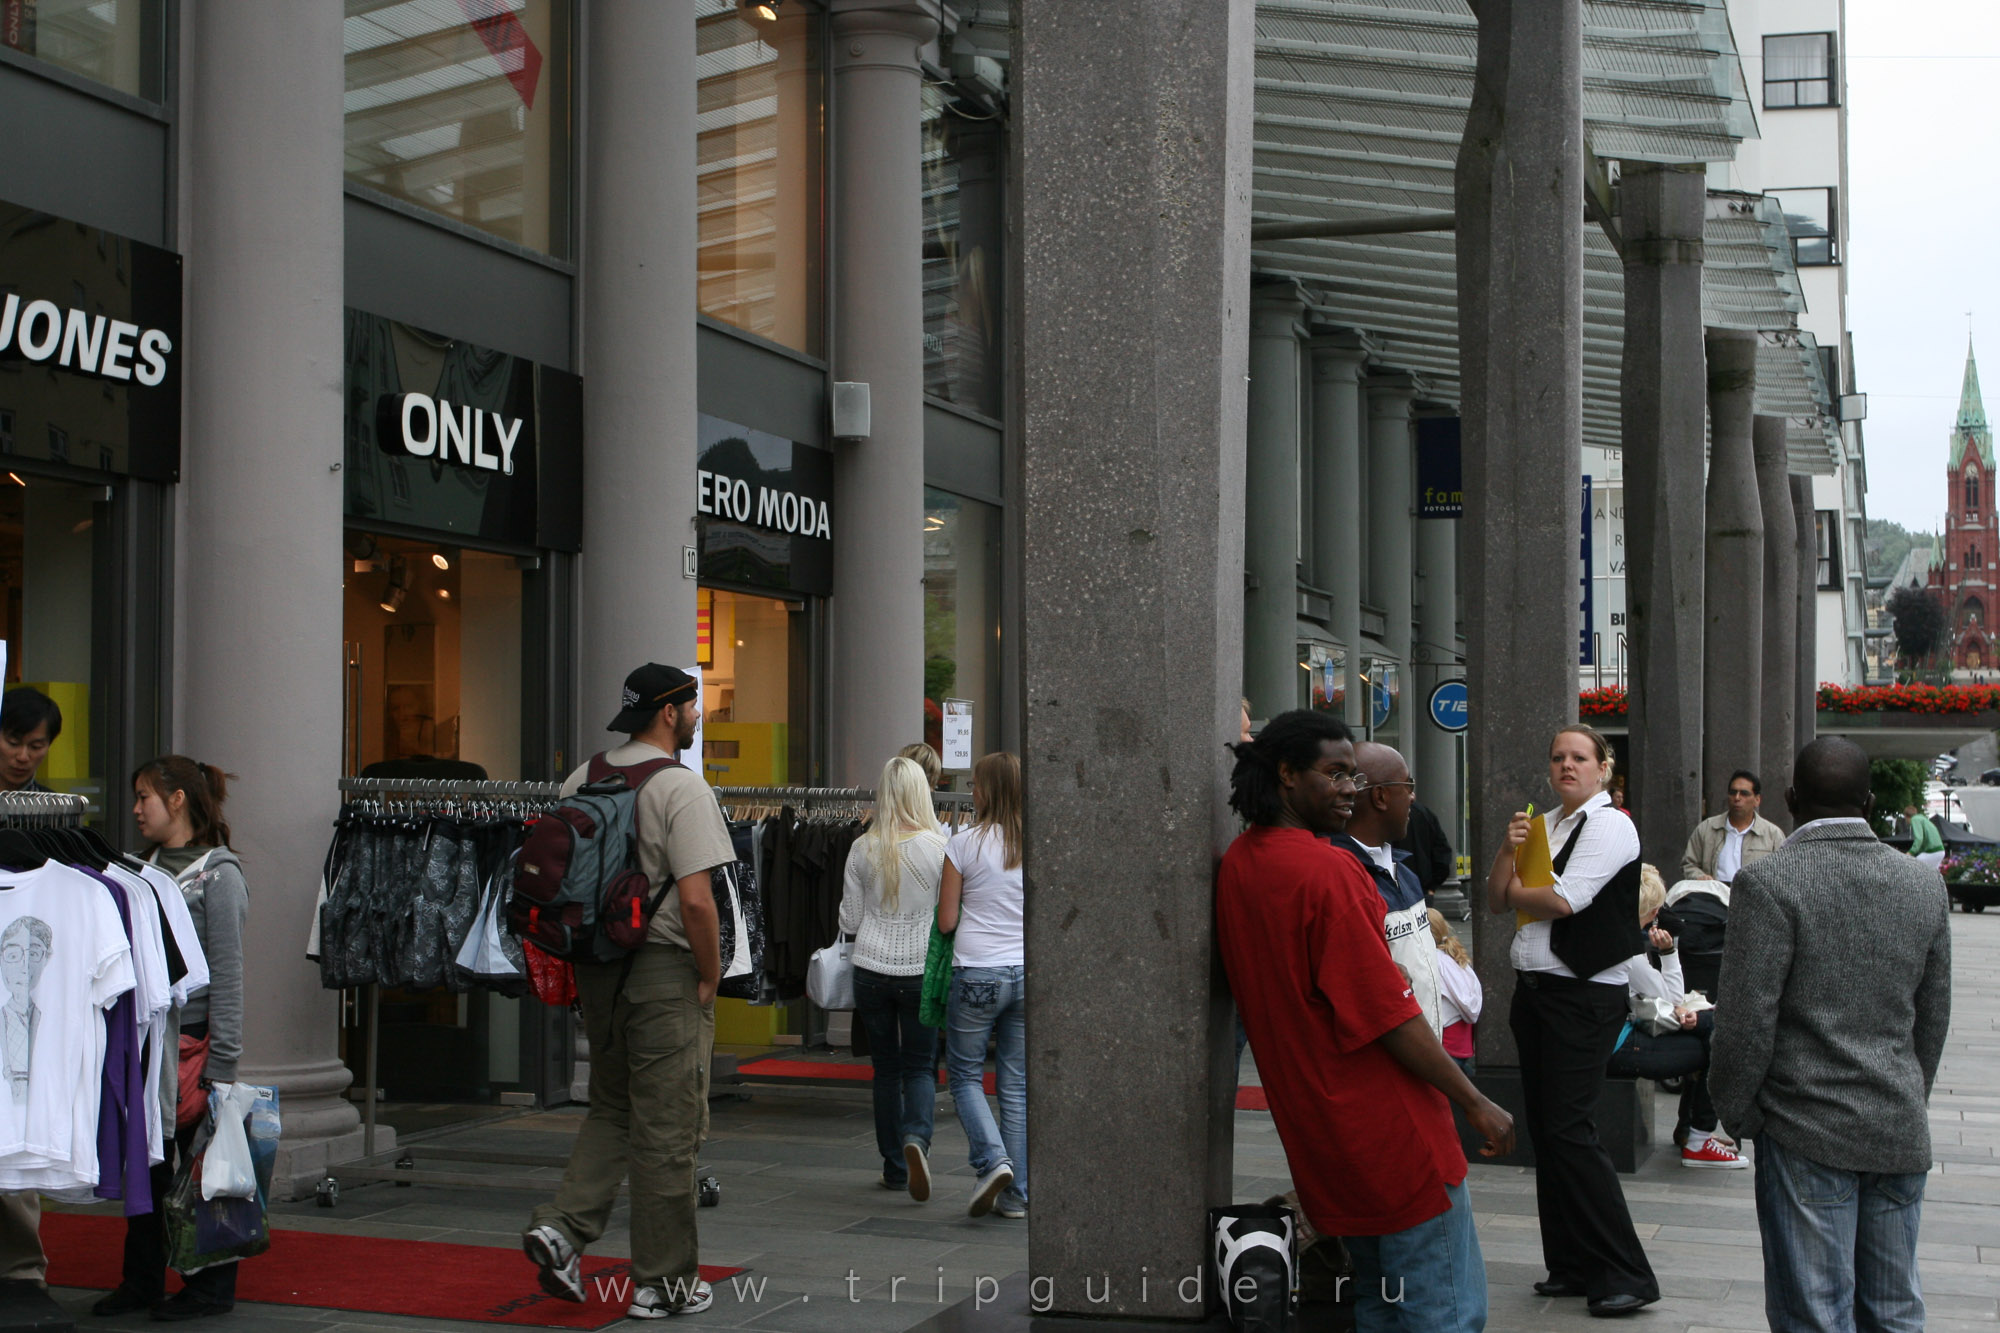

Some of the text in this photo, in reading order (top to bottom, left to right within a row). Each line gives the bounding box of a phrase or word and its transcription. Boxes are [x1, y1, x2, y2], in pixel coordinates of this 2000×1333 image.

[0, 293, 172, 386] JONES
[402, 392, 523, 475] ONLY
[698, 469, 831, 540] ERO MODA
[1424, 487, 1464, 504] fam
[687, 550, 696, 573] 10
